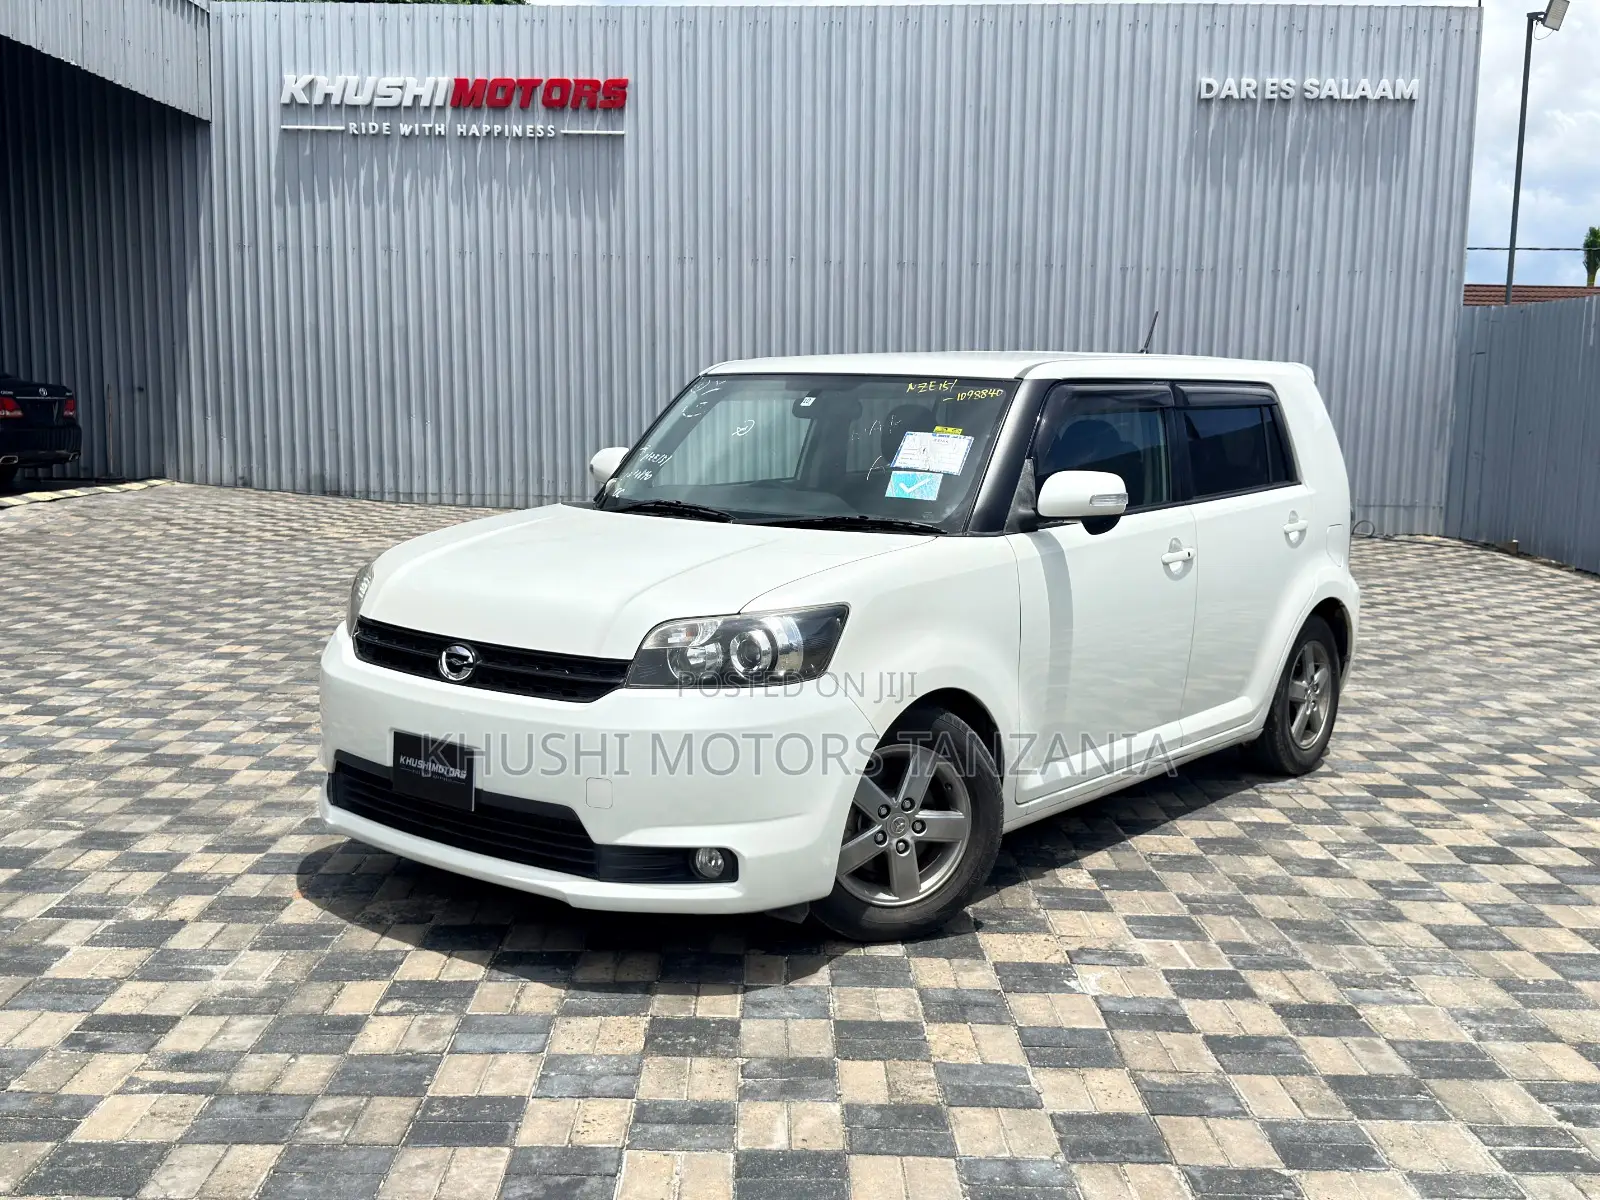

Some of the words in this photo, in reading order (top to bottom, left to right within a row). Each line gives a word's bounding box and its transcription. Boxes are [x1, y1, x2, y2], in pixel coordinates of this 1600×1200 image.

[1200, 78, 1257, 99] DAR
[1265, 78, 1297, 99] ES
[1303, 78, 1420, 99] SALAAM
[349, 122, 391, 135] RIDE
[400, 123, 445, 136] WITH
[457, 124, 556, 137] HAPPINESS
